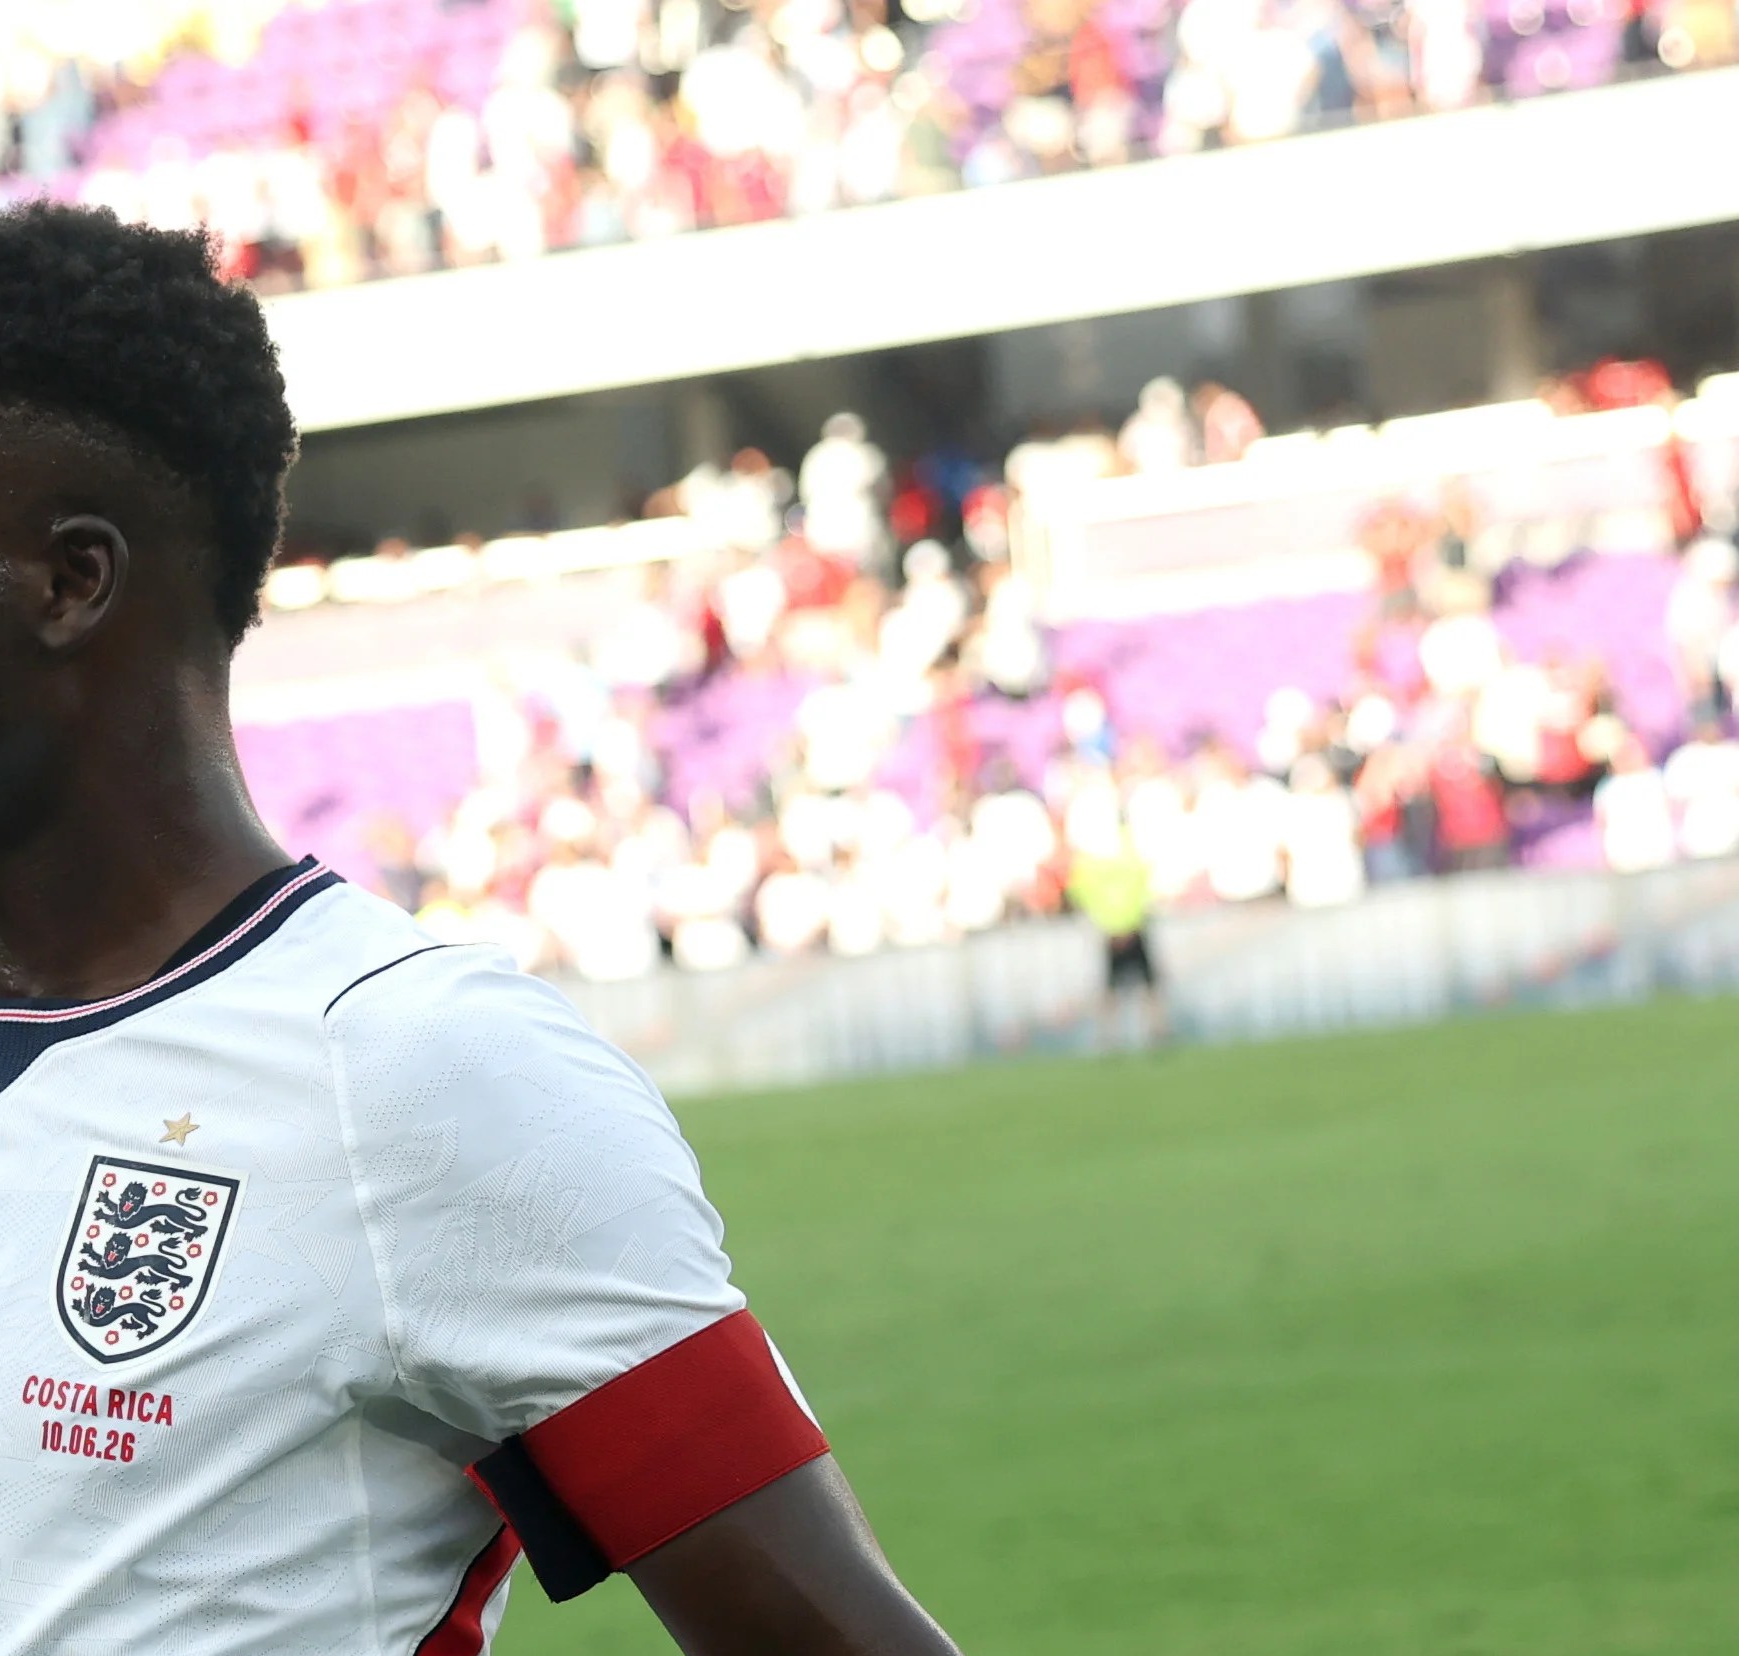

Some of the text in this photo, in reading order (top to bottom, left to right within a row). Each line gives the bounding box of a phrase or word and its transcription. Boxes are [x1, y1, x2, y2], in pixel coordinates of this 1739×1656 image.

[22, 1374, 174, 1427] COSTA RICA
[41, 1419, 136, 1463] 10.06.26
